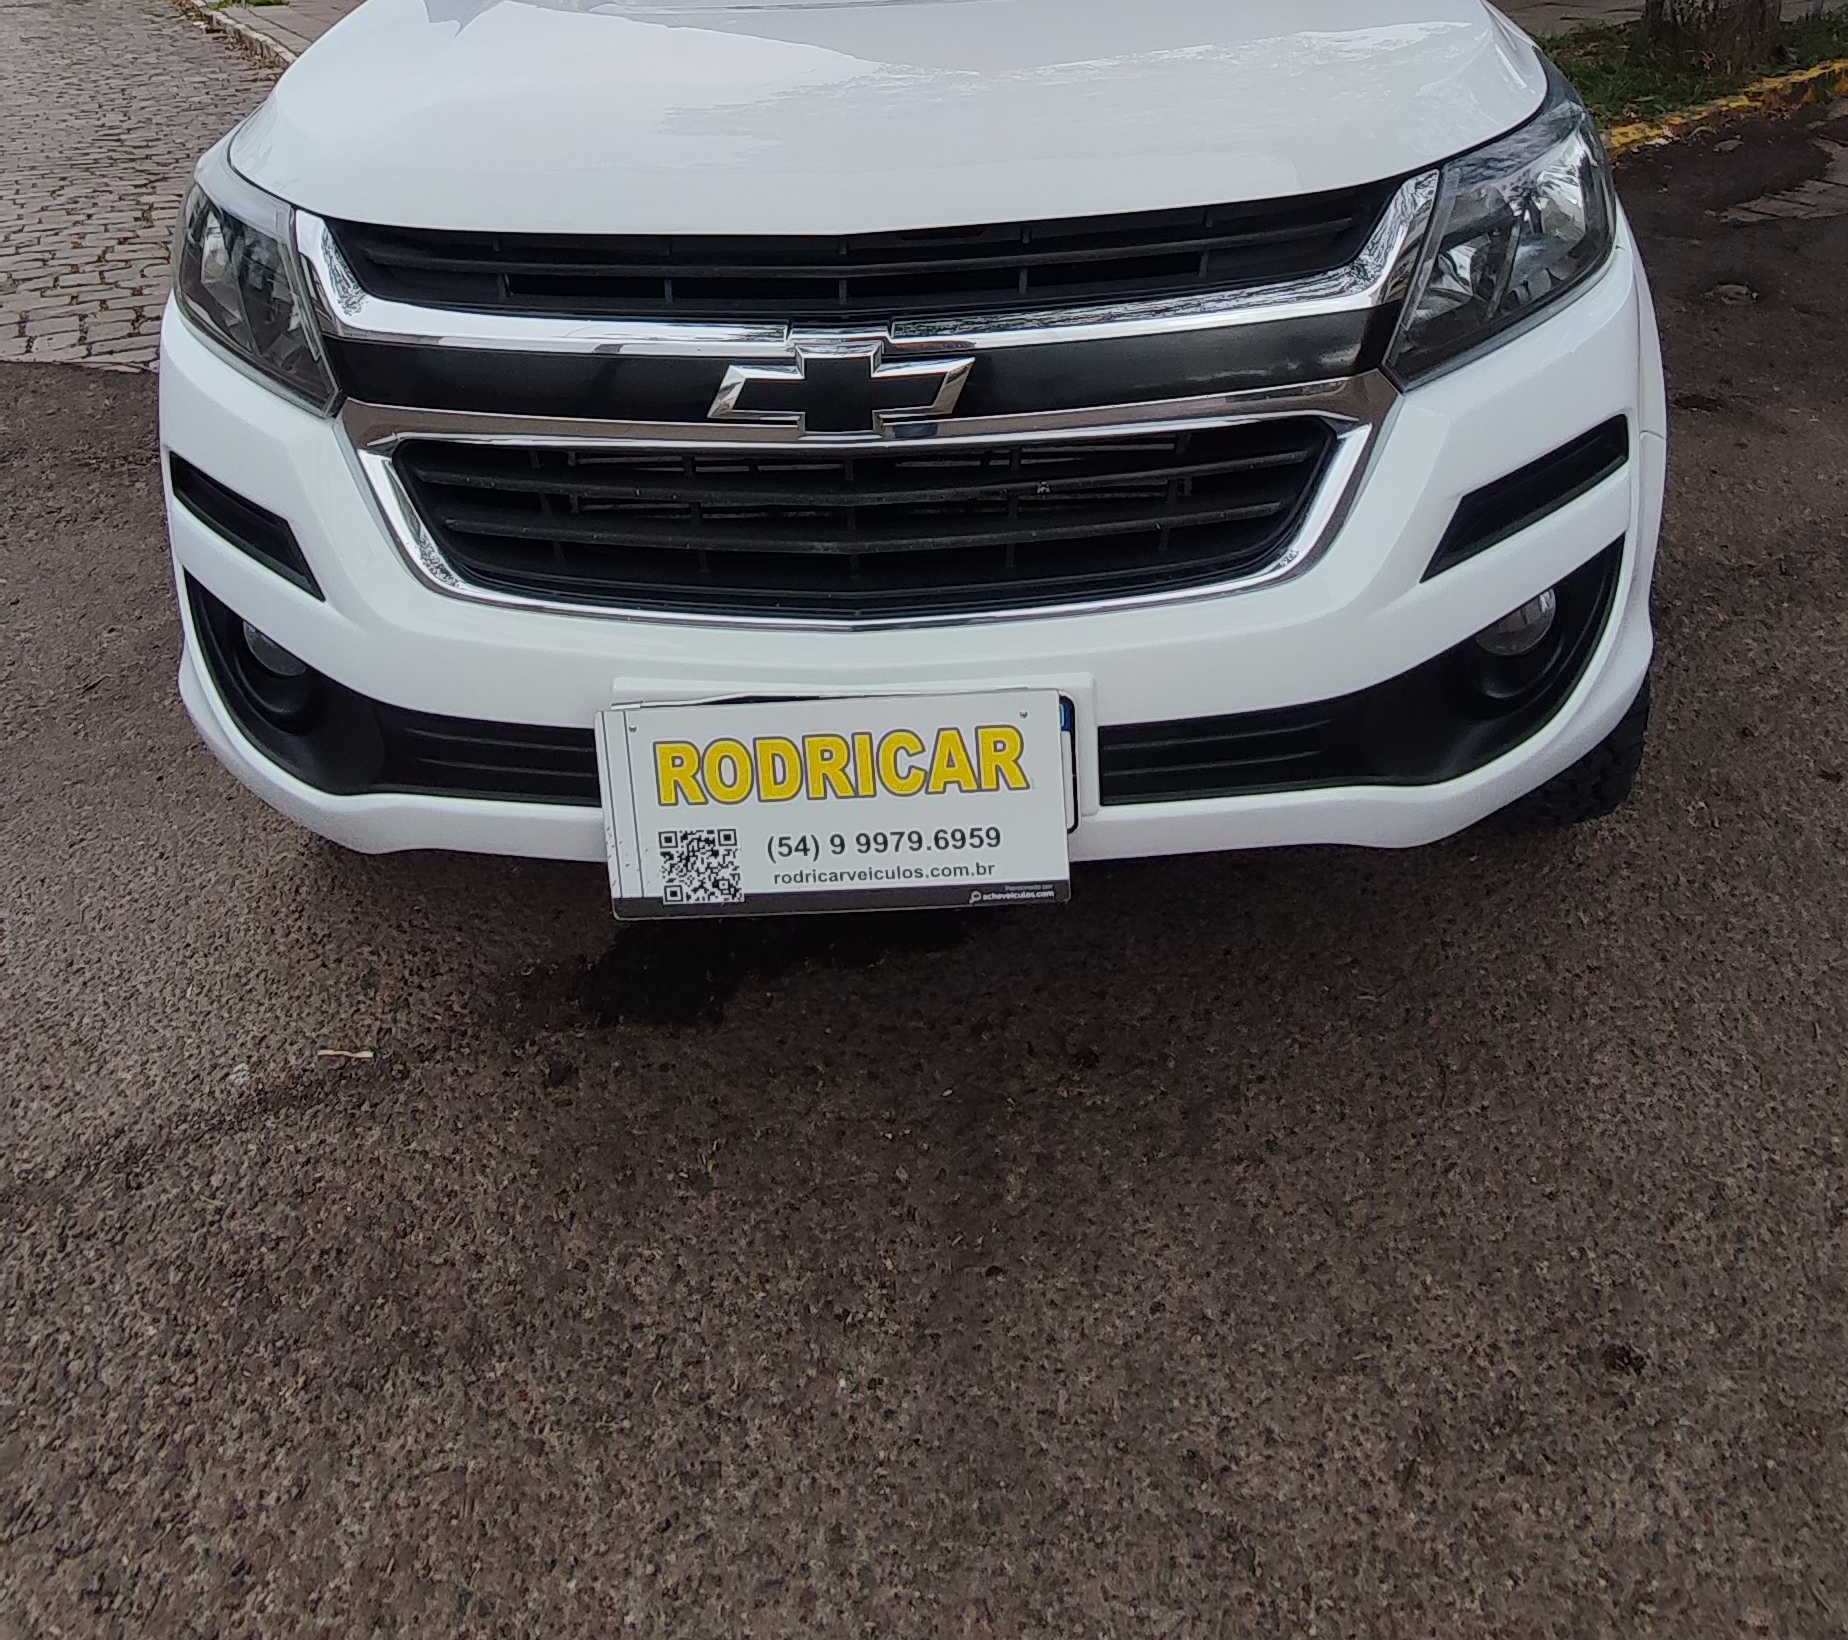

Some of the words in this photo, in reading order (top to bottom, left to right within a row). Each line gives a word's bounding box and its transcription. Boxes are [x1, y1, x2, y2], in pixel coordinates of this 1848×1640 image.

[653, 724, 1031, 807] RODRICAR
[766, 833, 820, 863] (54)
[829, 833, 846, 855] 9
[855, 826, 1001, 854] 9979.6959
[774, 862, 996, 885] rodricarveiculos.com.br
